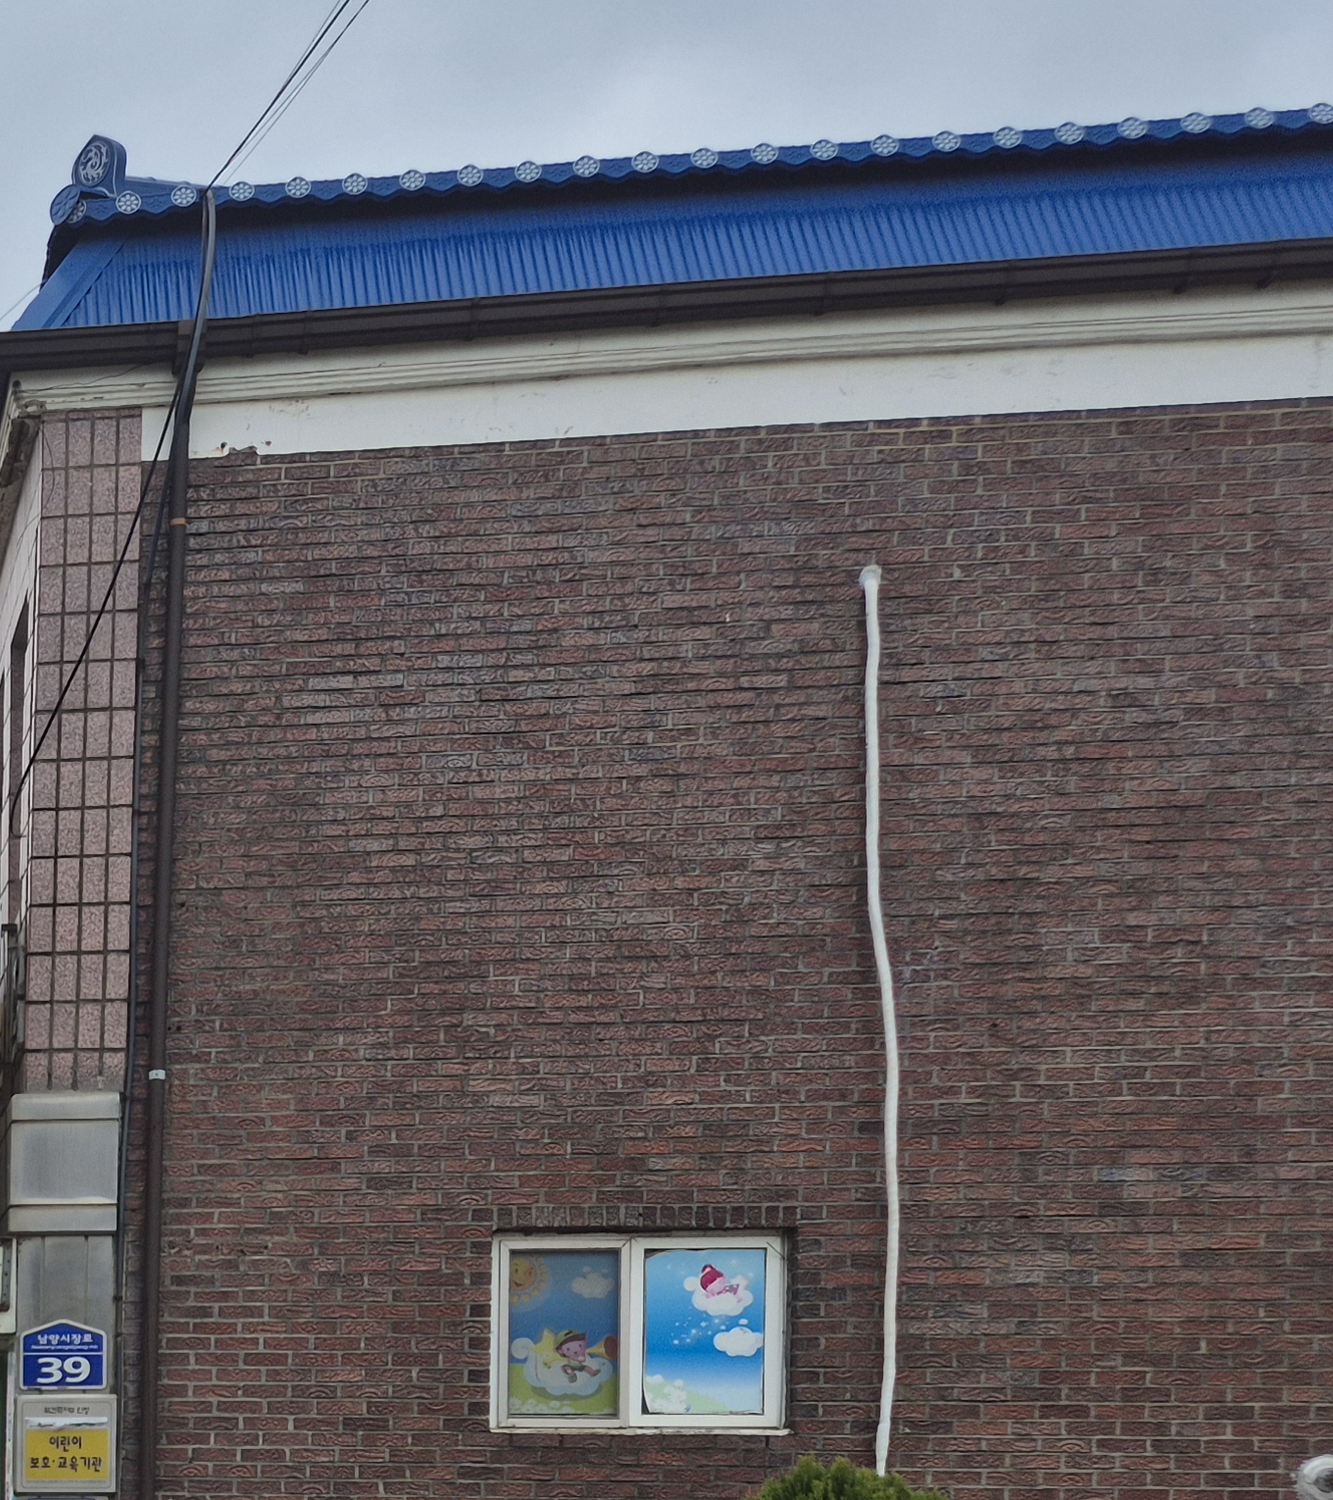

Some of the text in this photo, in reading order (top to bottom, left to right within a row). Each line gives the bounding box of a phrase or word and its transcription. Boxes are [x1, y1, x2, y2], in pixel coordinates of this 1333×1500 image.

[37, 1333, 93, 1345] 남양시장로
[37, 1356, 91, 1384] 39
[49, 1435, 82, 1452] 어린이
